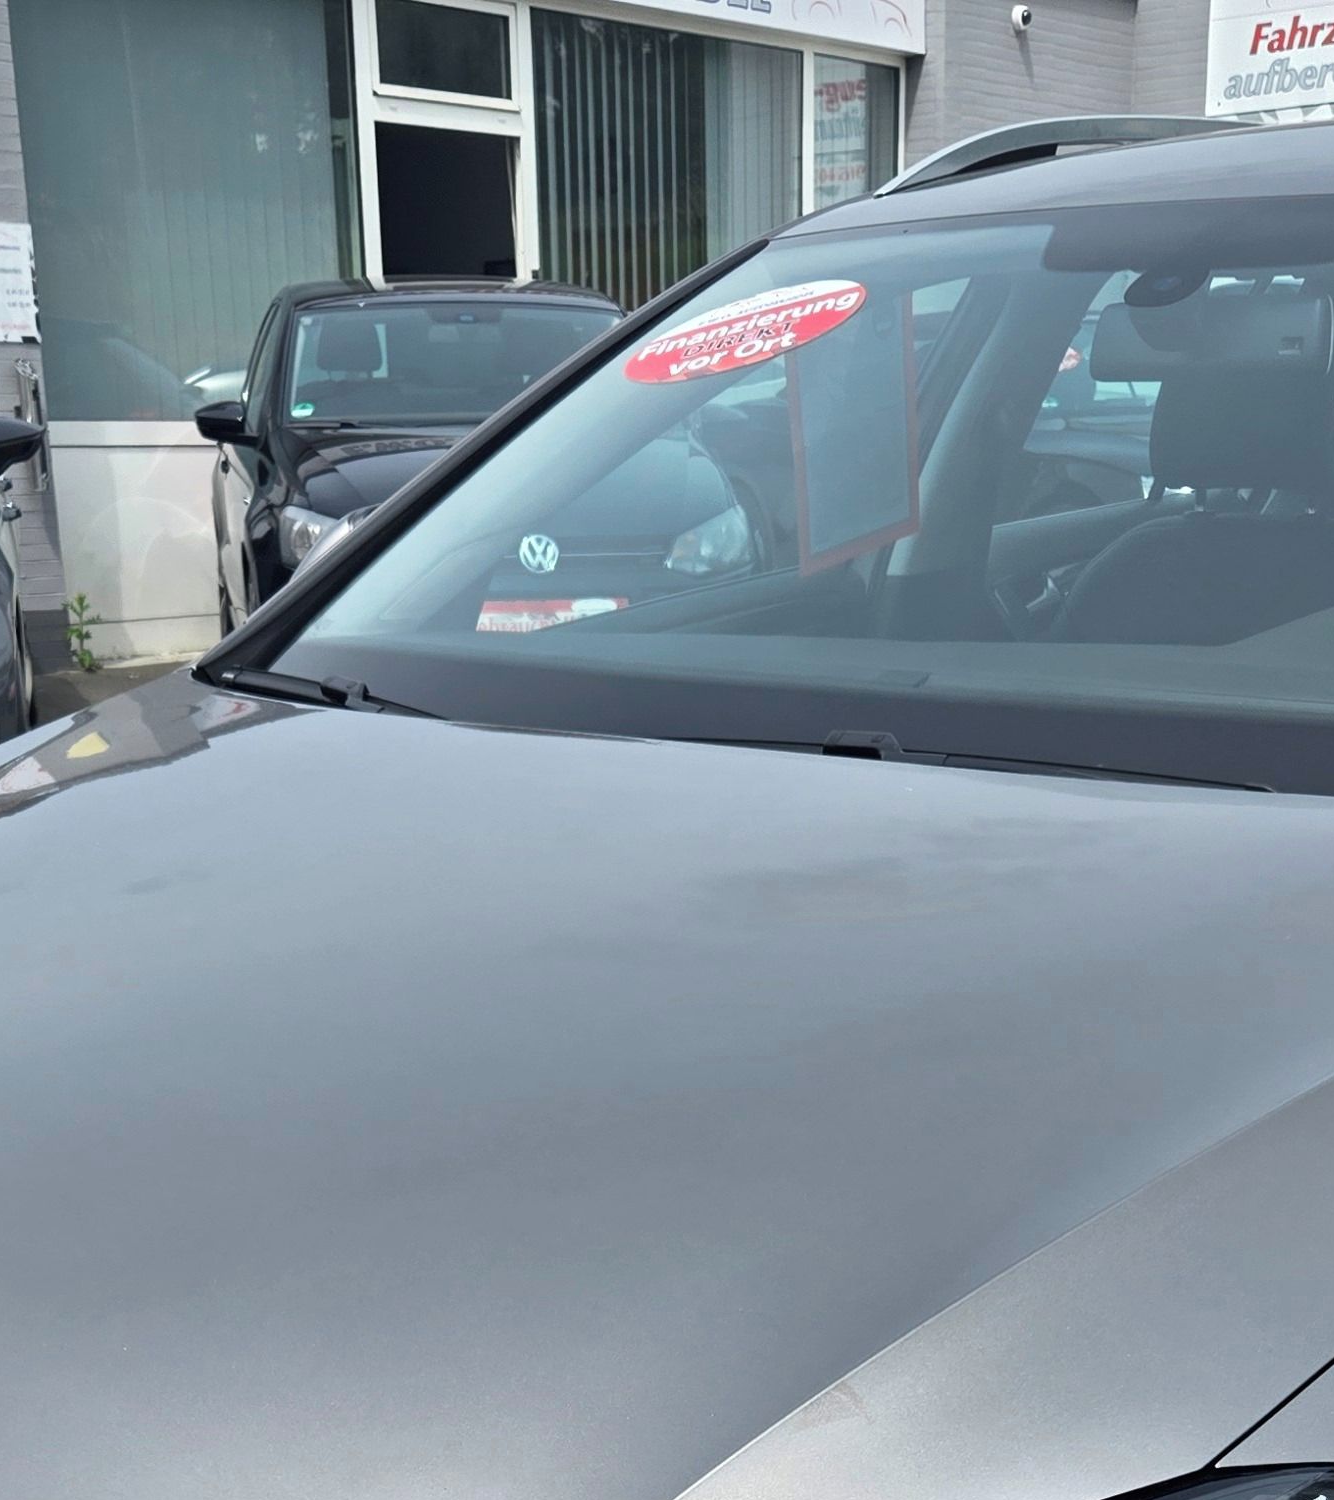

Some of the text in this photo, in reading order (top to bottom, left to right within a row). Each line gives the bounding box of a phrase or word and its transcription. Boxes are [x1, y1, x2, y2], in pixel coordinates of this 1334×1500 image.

[638, 290, 860, 361] Finanzierung
[682, 319, 801, 358] DIREKT
[668, 331, 796, 376] vor Ort
